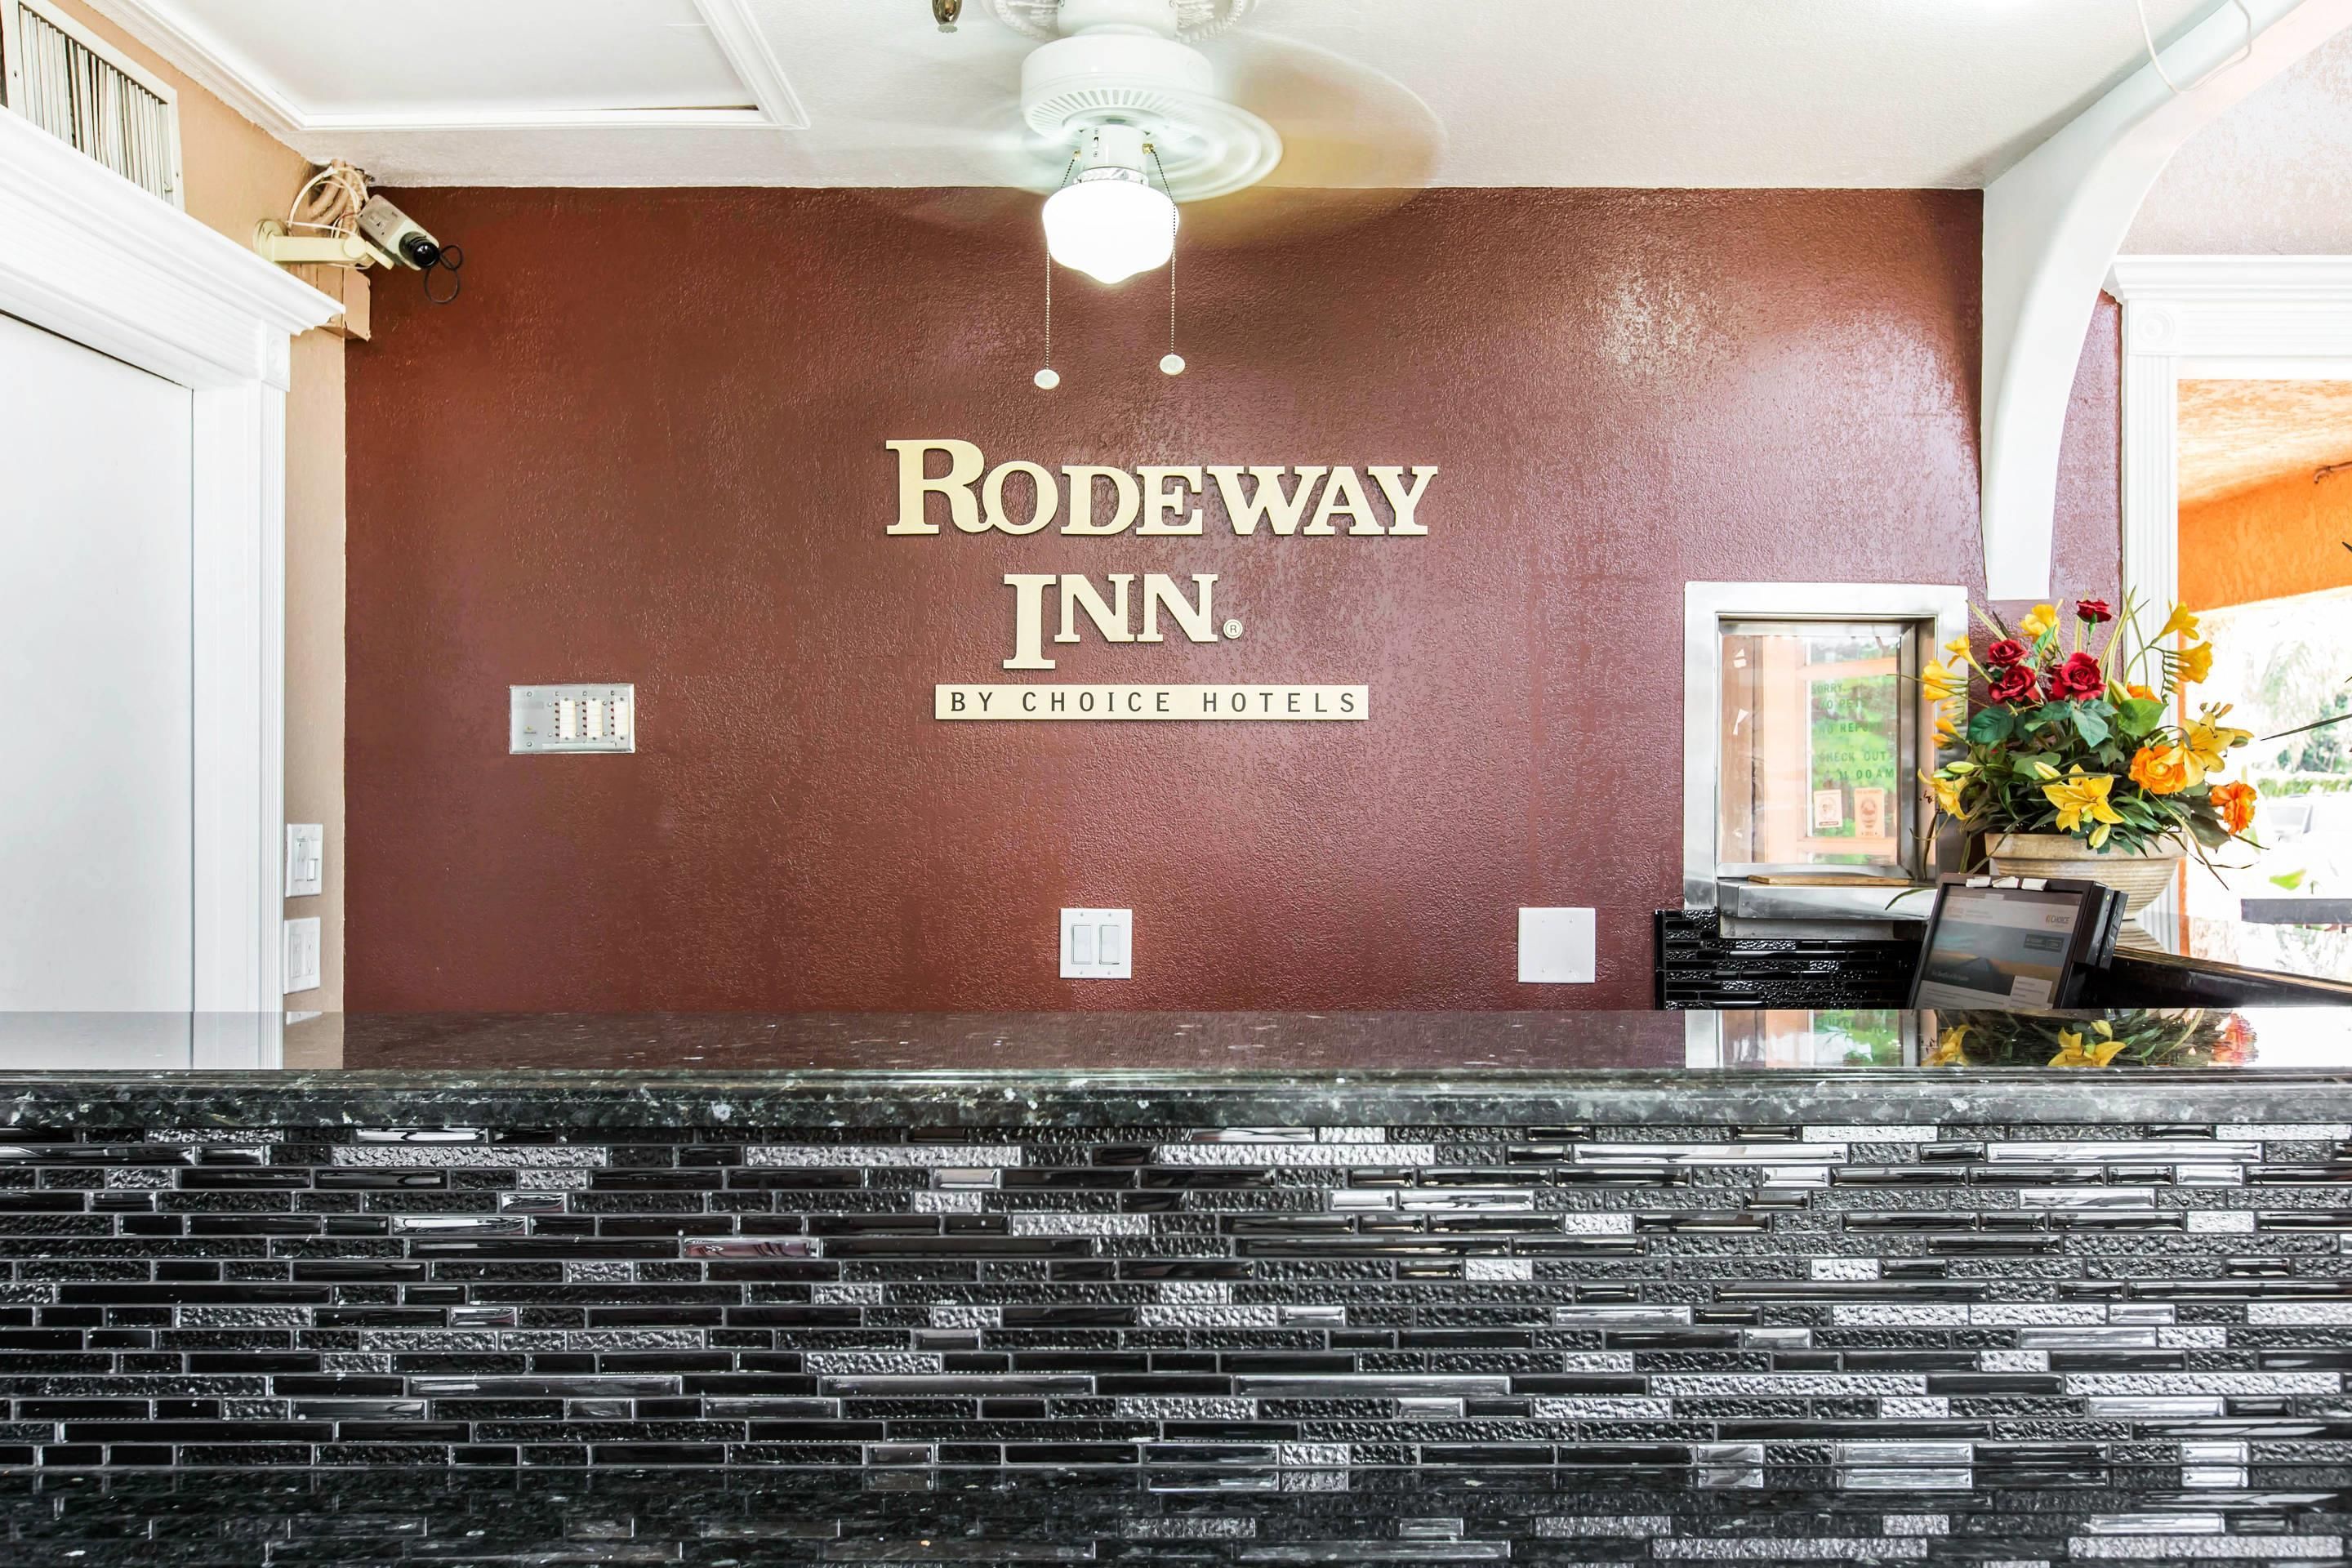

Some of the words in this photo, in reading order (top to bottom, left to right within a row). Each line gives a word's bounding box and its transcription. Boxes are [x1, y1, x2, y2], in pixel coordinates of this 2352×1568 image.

[886, 439, 1438, 535] RODEWAY
[1004, 574, 1218, 669] INN
[951, 693, 992, 712] BY
[1023, 693, 1169, 712] CHOICE
[1204, 693, 1354, 713] HOTELS
[1864, 751, 1886, 761] OUT
